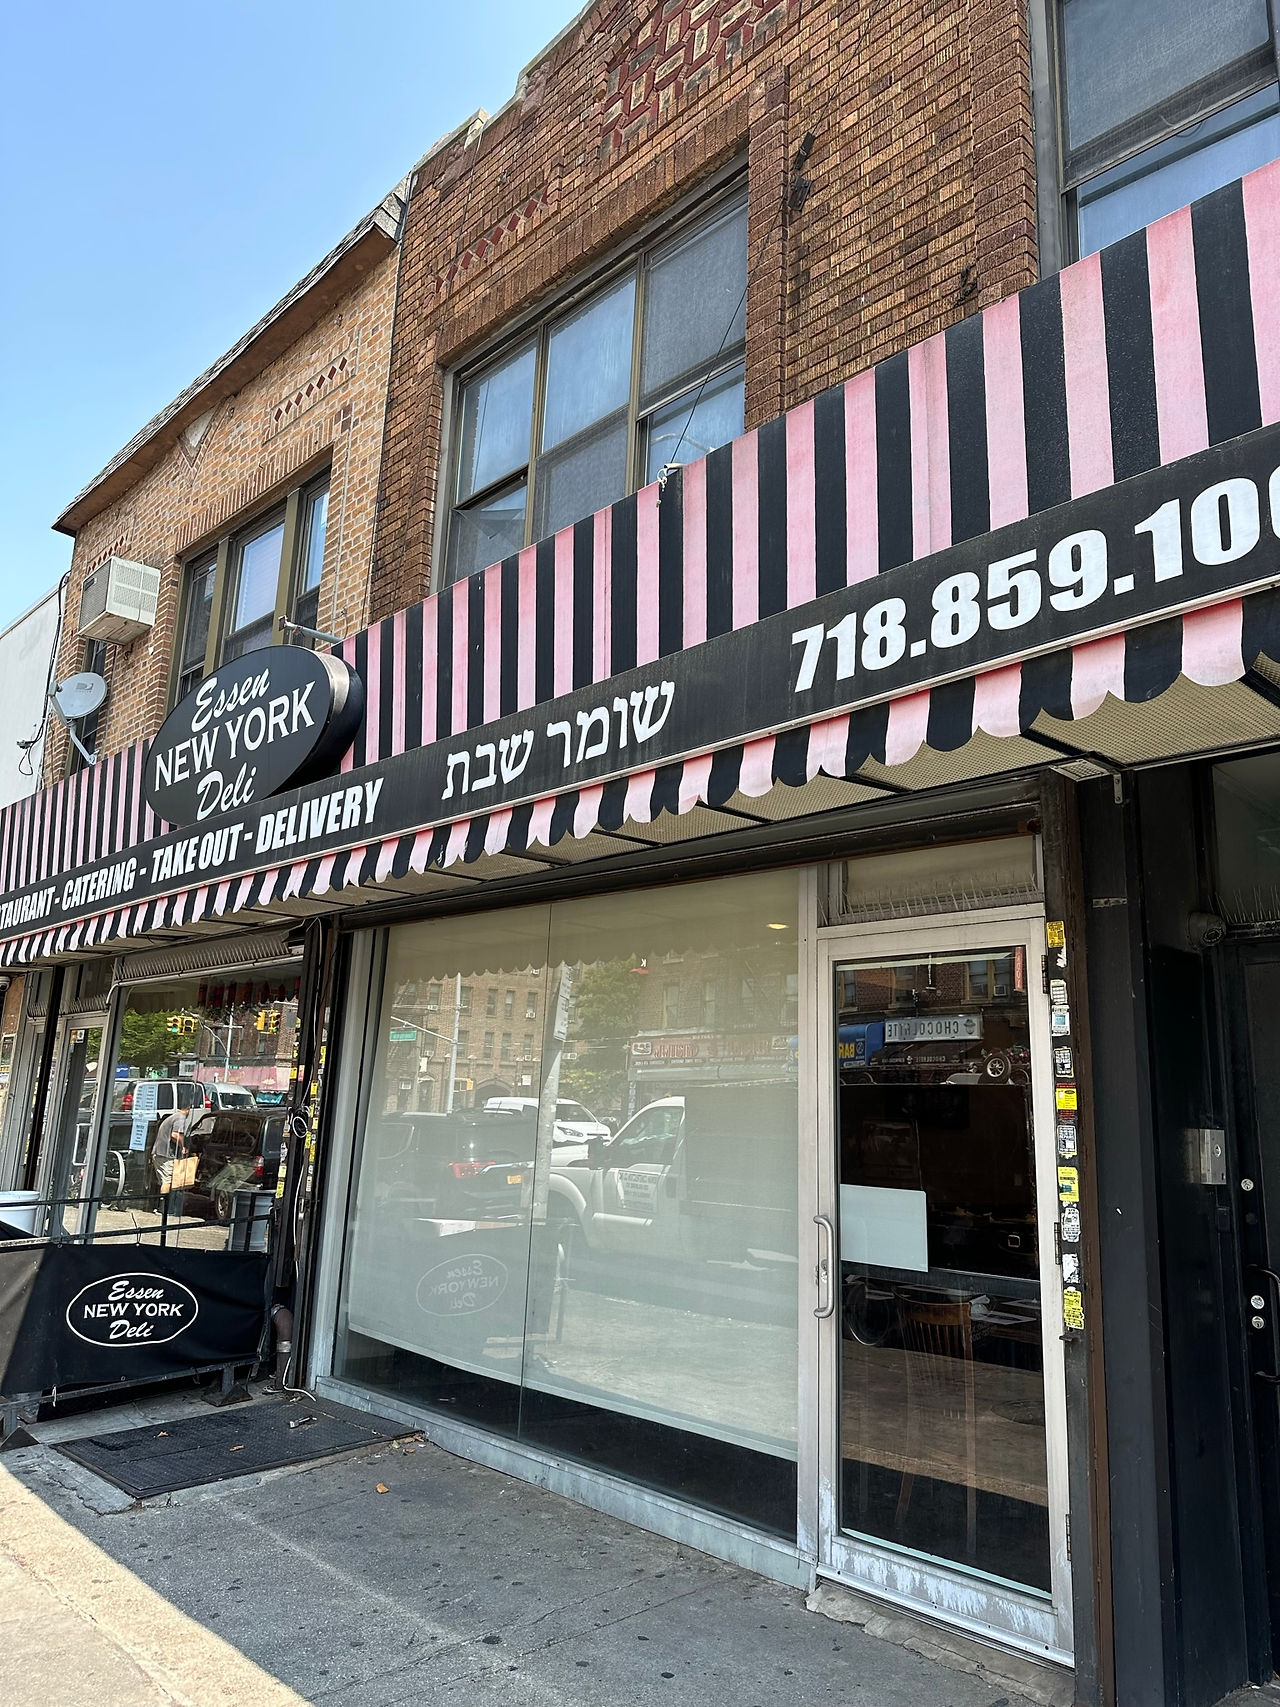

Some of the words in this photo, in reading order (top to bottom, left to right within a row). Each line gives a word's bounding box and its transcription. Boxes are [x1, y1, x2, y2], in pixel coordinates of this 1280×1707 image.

[792, 465, 1280, 693] 718.859.10
[191, 668, 270, 733] Essen
[546, 680, 676, 768] שומר
[154, 725, 220, 792] NEW
[224, 680, 317, 760] YORK
[441, 729, 535, 800] שבת
[196, 762, 258, 821] Deli
[0, 885, 57, 930] TAURANT
[61, 857, 138, 911] CATERING
[151, 835, 200, 884] TAKE
[199, 822, 245, 870] OUT
[255, 777, 385, 855] DELIVERY
[83, 1302, 130, 1319] NEW
[133, 1302, 185, 1317] YORK
[107, 1280, 165, 1301] Essen
[109, 1319, 155, 1339] Deli
